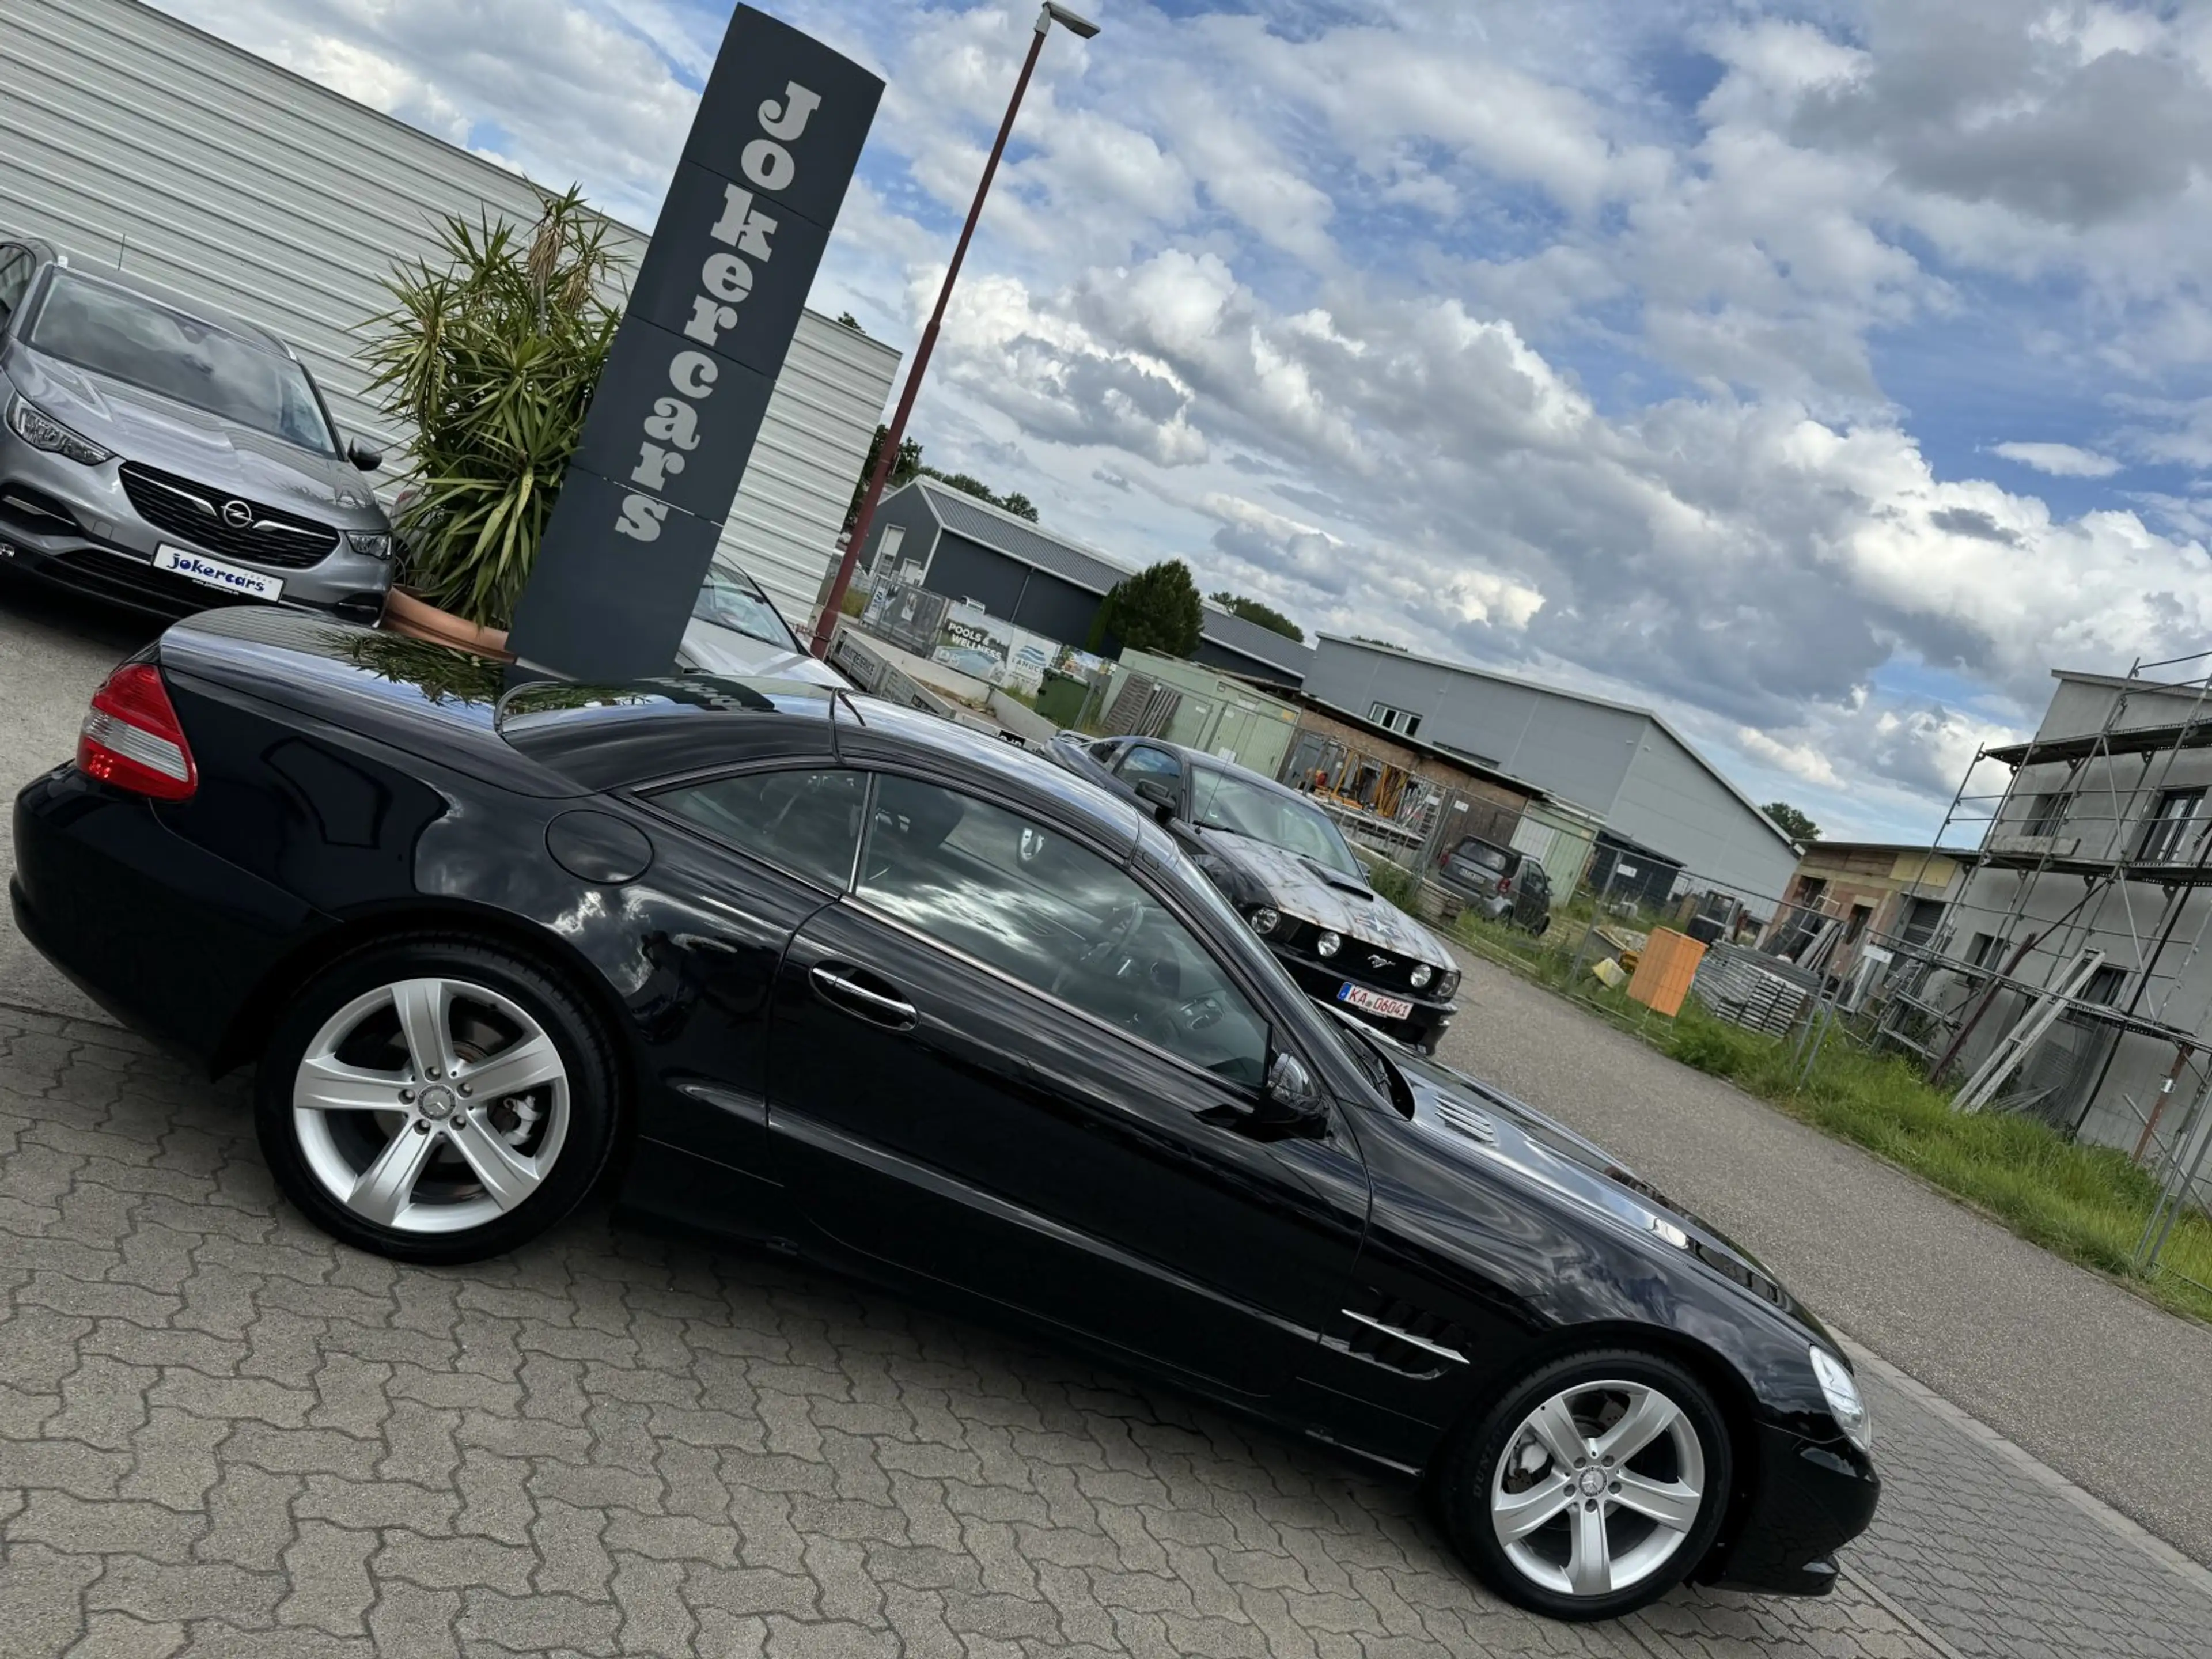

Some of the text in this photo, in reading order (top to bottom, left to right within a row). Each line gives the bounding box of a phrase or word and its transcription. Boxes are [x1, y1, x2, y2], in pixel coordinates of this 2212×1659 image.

[615, 80, 821, 542] Jokercars
[166, 553, 264, 592] jokercars
[948, 622, 990, 646] POOLS &
[952, 634, 1002, 661] WELLNESS
[1349, 988, 1368, 1005] KA
[1373, 998, 1408, 1017] 06041
